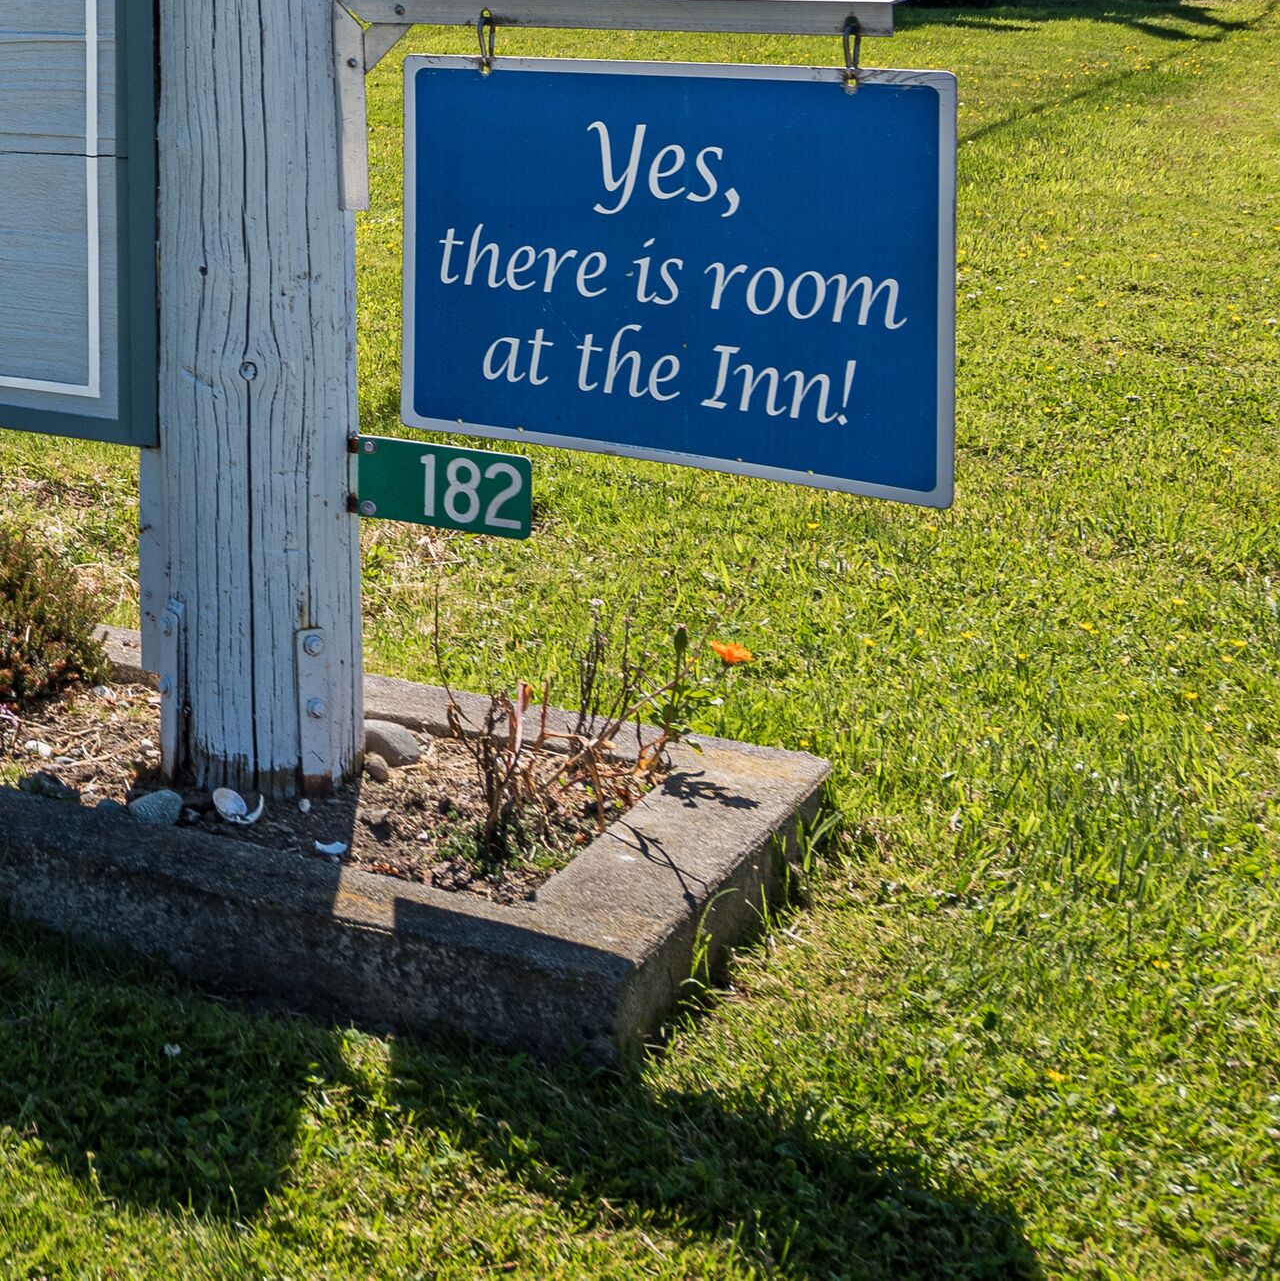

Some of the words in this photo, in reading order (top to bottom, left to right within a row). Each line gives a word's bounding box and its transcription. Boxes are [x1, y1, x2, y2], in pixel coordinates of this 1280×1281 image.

[587, 120, 740, 218] Yes,
[439, 223, 607, 298] there
[633, 238, 684, 305] is
[704, 262, 907, 330] room
[483, 328, 554, 386] at
[576, 324, 680, 401] the
[700, 344, 857, 426] Inn!
[420, 453, 522, 529] 182
